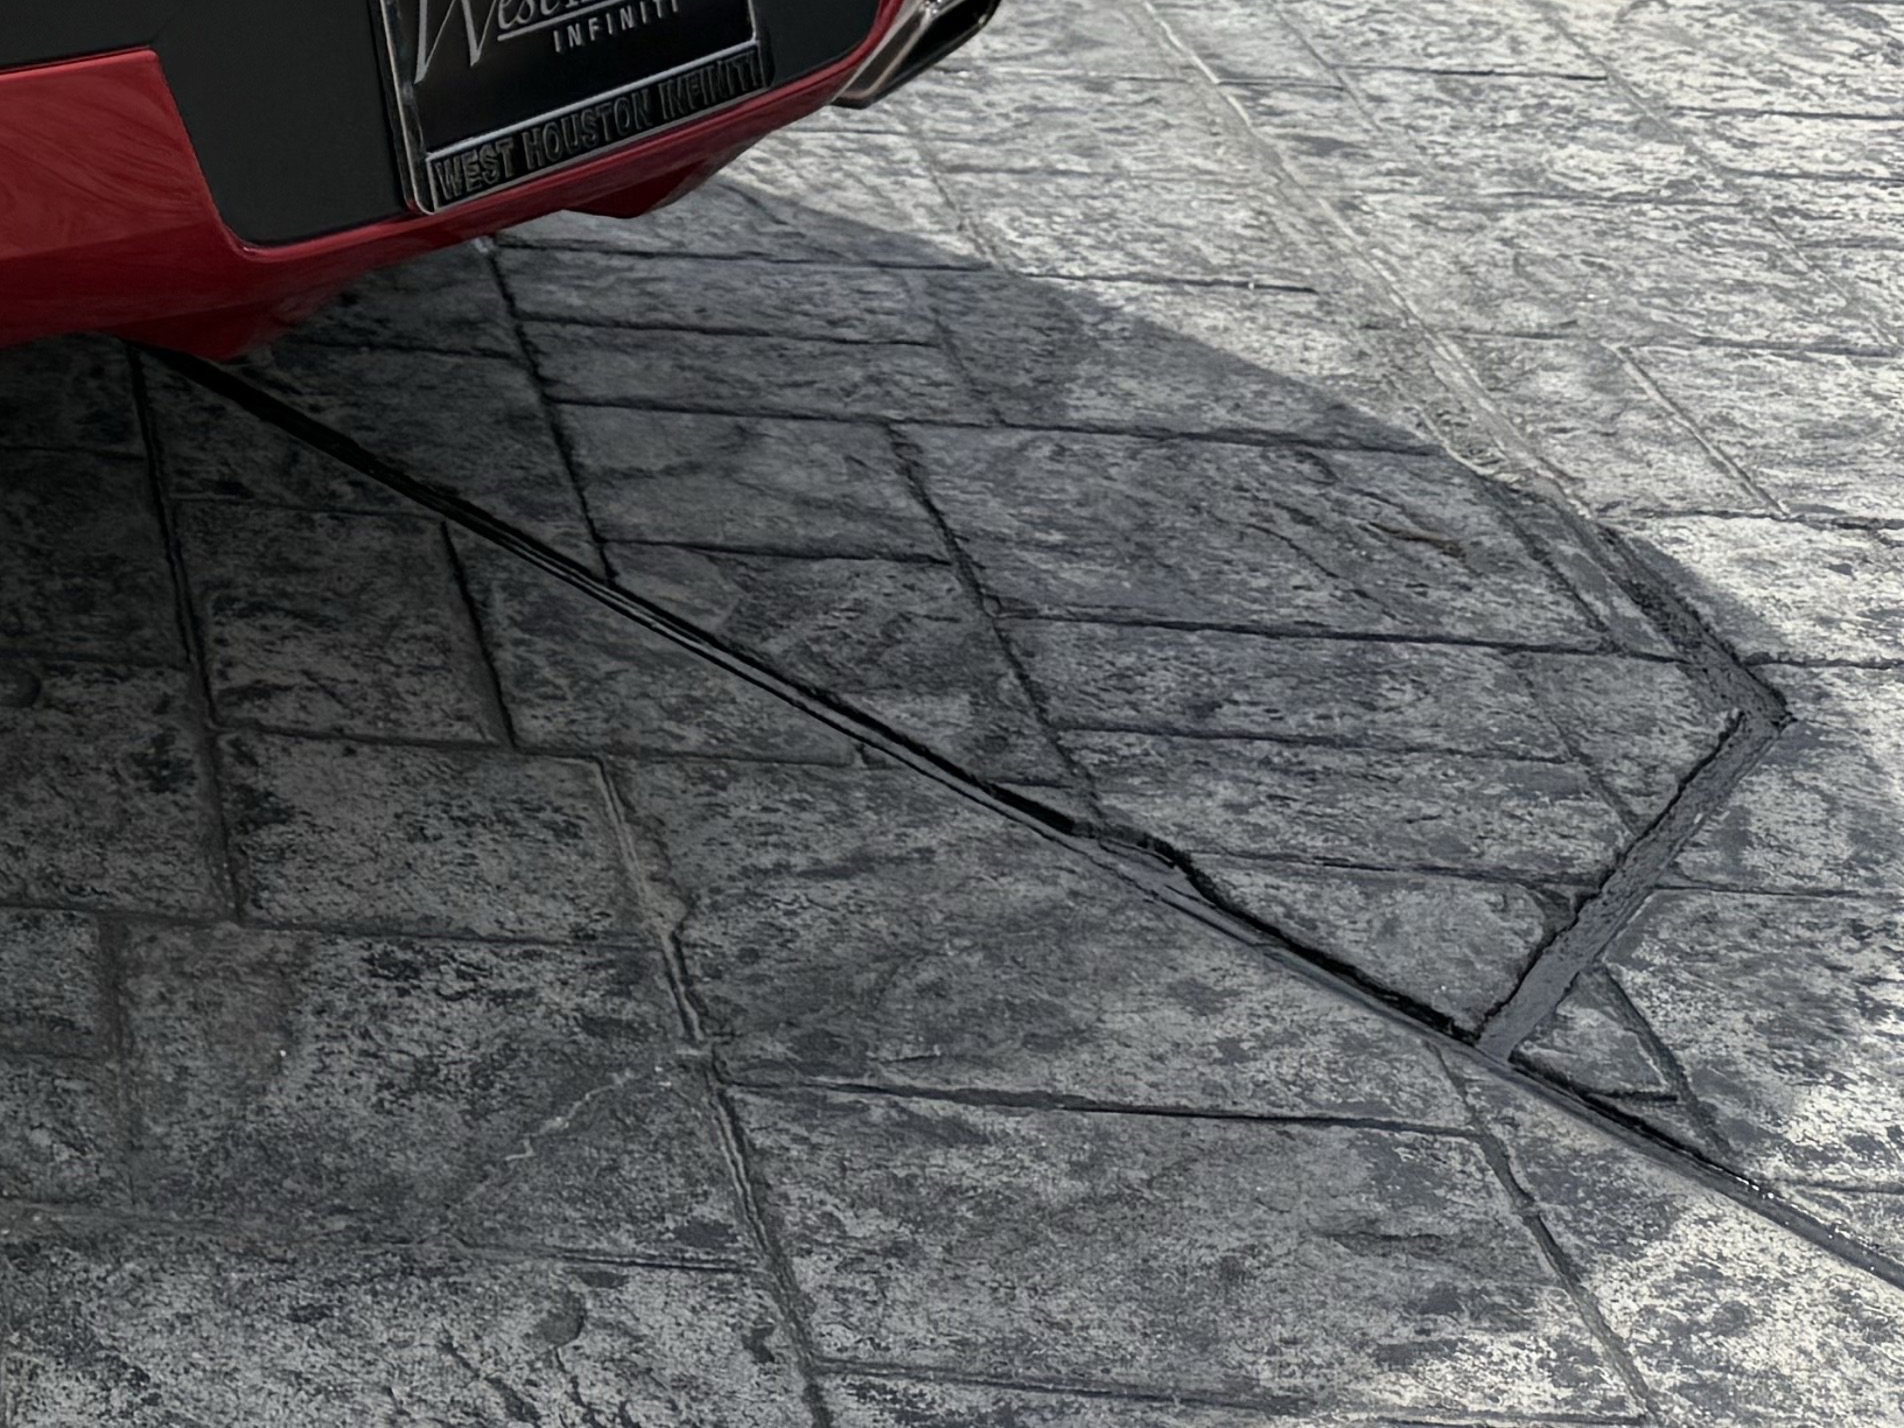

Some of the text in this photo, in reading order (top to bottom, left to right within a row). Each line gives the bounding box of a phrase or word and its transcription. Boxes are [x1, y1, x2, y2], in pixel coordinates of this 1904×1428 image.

[435, 48, 760, 202] WEST HOUSTON INFINITI
